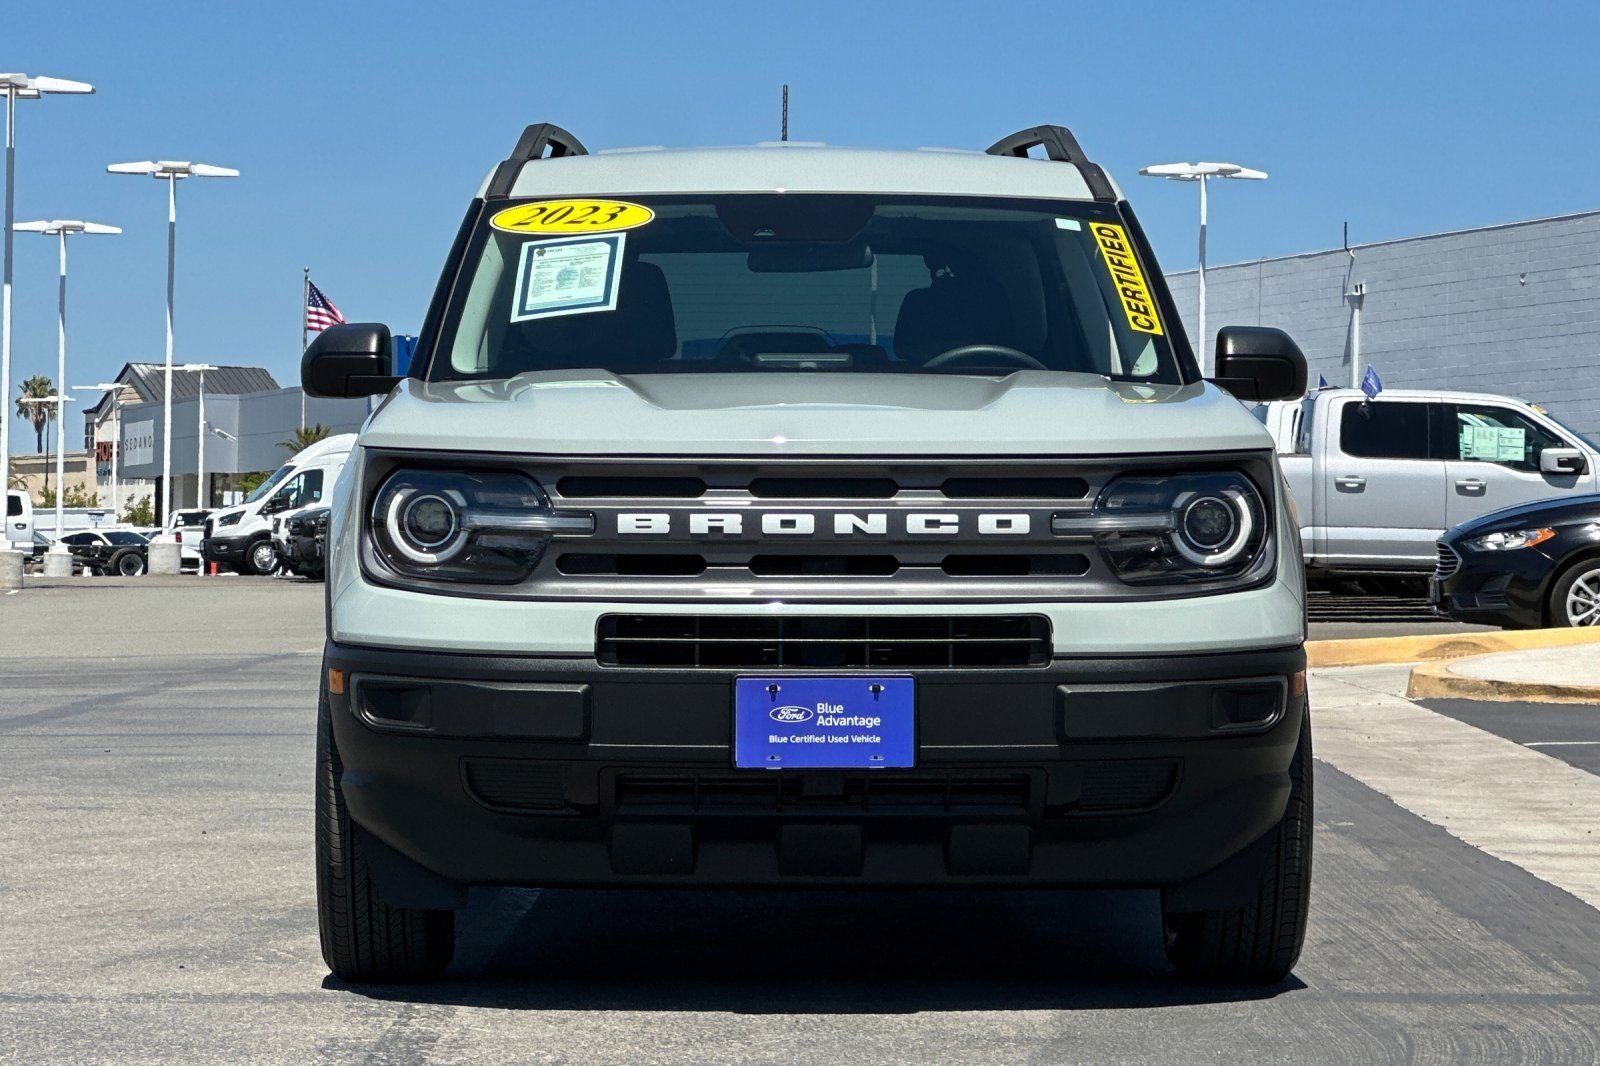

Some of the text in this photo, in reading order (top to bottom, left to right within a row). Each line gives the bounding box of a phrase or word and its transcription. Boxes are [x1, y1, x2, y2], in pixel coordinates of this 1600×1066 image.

[510, 205, 628, 227] 2023
[1096, 226, 1154, 330] CERTIFIED
[617, 513, 1031, 535] BRONCO
[777, 707, 806, 721] Ford
[817, 703, 844, 714] Blue
[816, 715, 881, 728] Advantage
[769, 735, 881, 743] Blue Certified Used Vehicle
